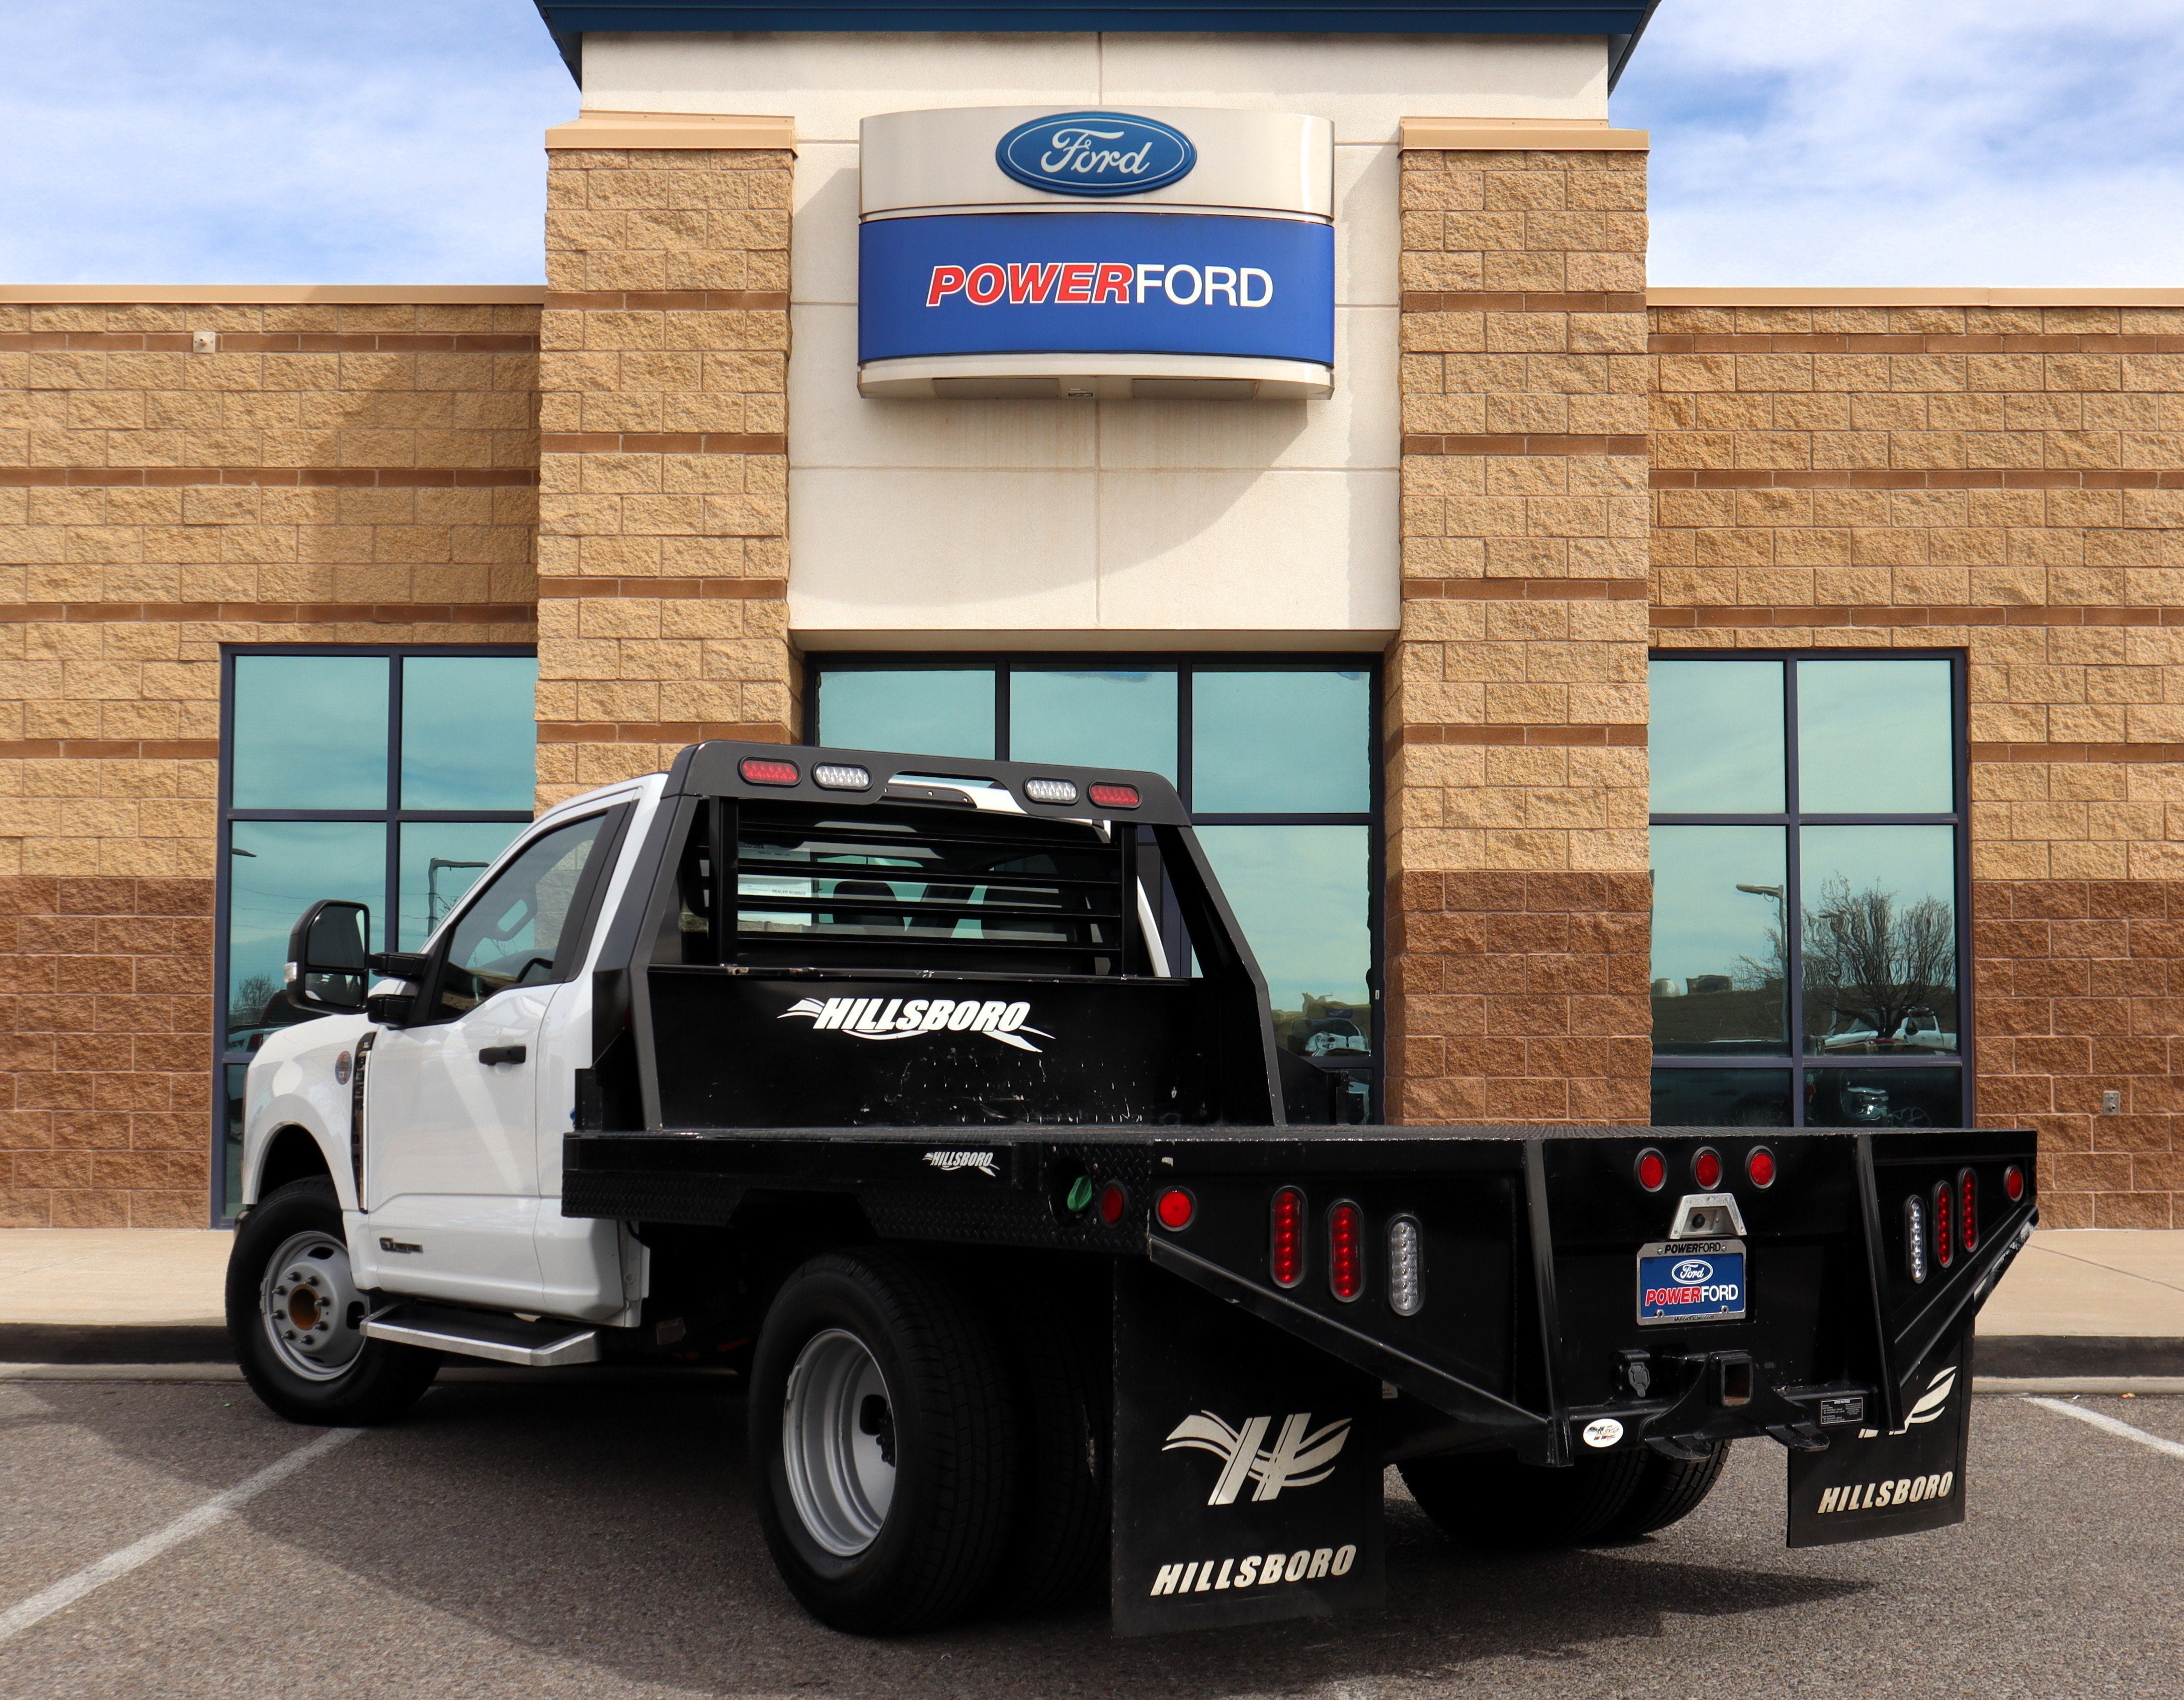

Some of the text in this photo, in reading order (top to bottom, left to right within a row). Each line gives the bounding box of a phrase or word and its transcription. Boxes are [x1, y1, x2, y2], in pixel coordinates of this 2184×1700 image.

[1041, 128, 1152, 174] Ford
[926, 263, 1273, 307] POWERFORD
[813, 998, 1030, 1032] HILLSBORO
[930, 1152, 993, 1167] HILLSBORO
[1665, 1243, 1721, 1253] POWERFORD
[1680, 1264, 1705, 1279] Ford
[1645, 1284, 1738, 1306] POWERFORD
[1818, 1471, 1954, 1514] HILLSBORO
[1150, 1545, 1356, 1596] HILLSBORO
